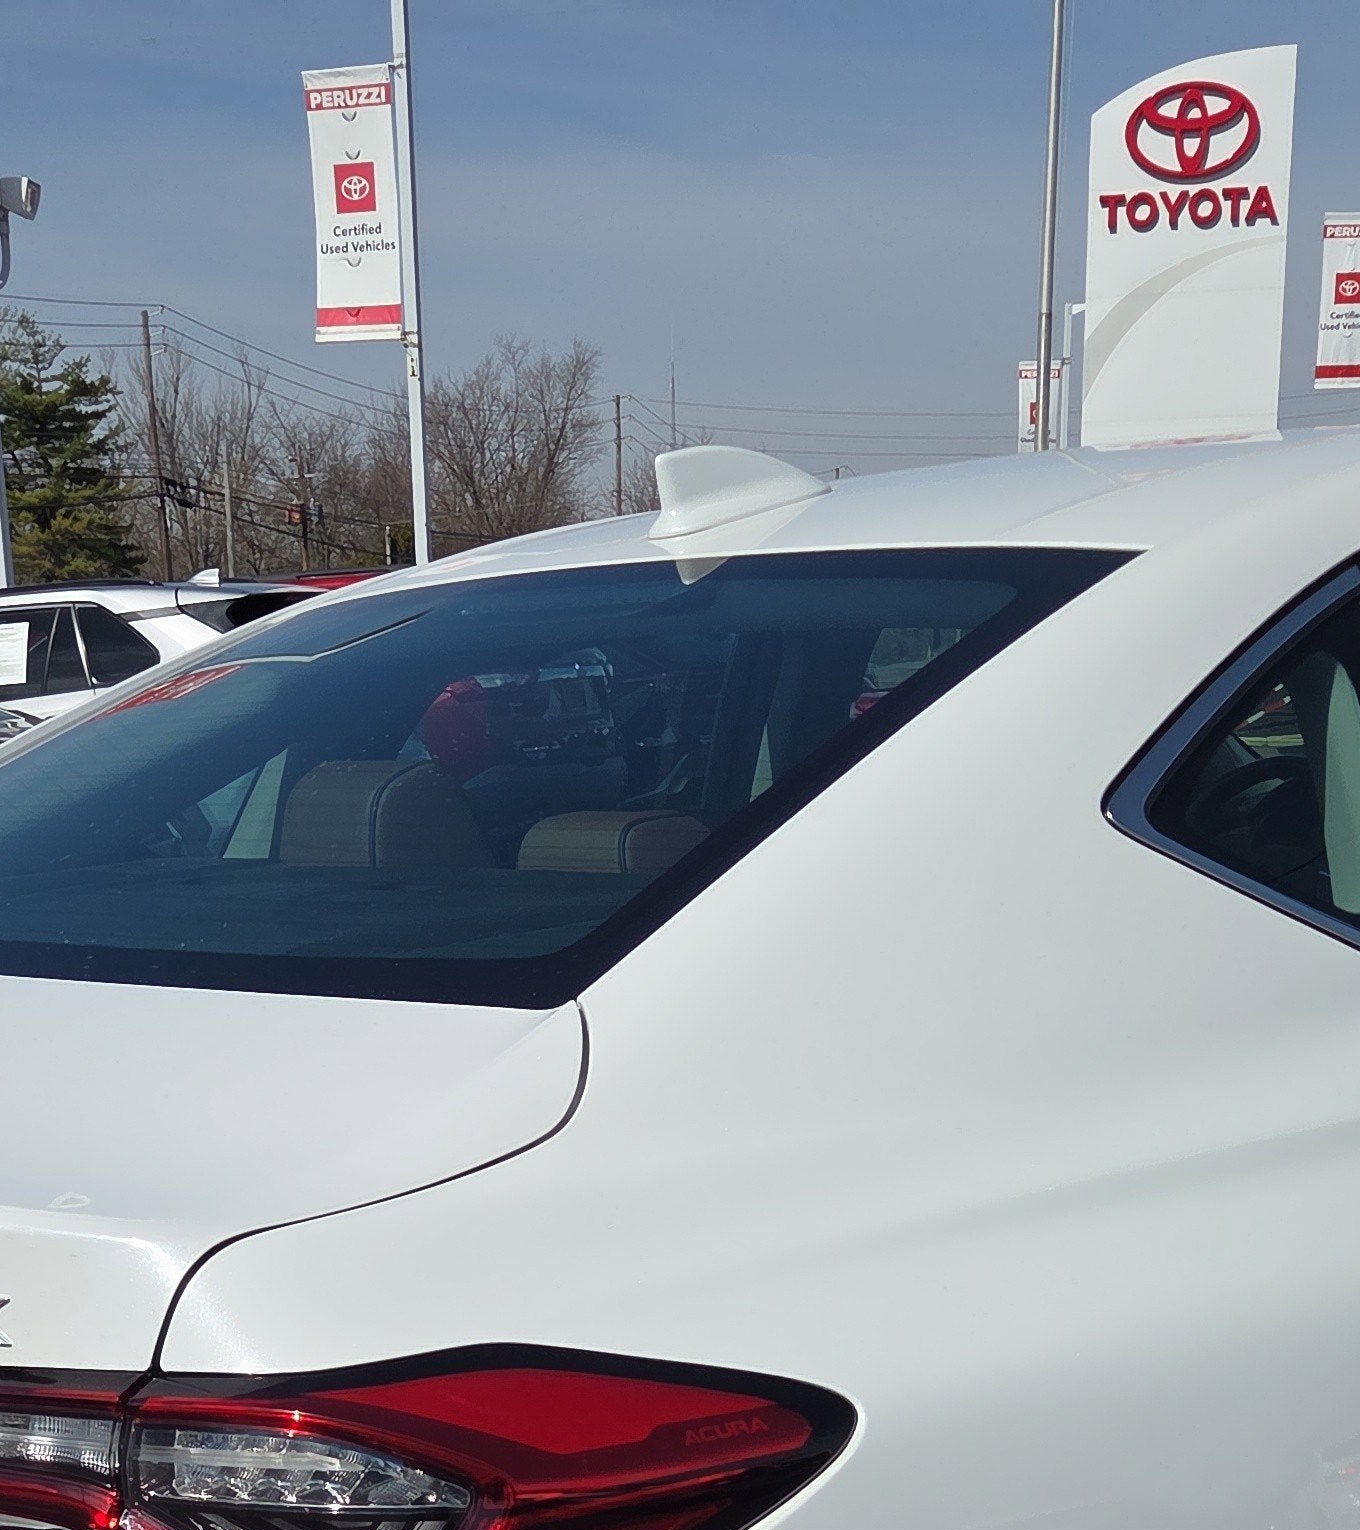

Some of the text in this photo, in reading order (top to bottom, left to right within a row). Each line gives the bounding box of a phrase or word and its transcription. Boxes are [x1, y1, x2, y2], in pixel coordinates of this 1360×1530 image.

[309, 86, 386, 109] PERUZZI
[1099, 186, 1279, 234] TOYOTA
[333, 222, 382, 237] Certified
[321, 239, 396, 255] Used Vehicles
[1320, 322, 1340, 331] Used
[685, 1418, 769, 1446] ACURA
